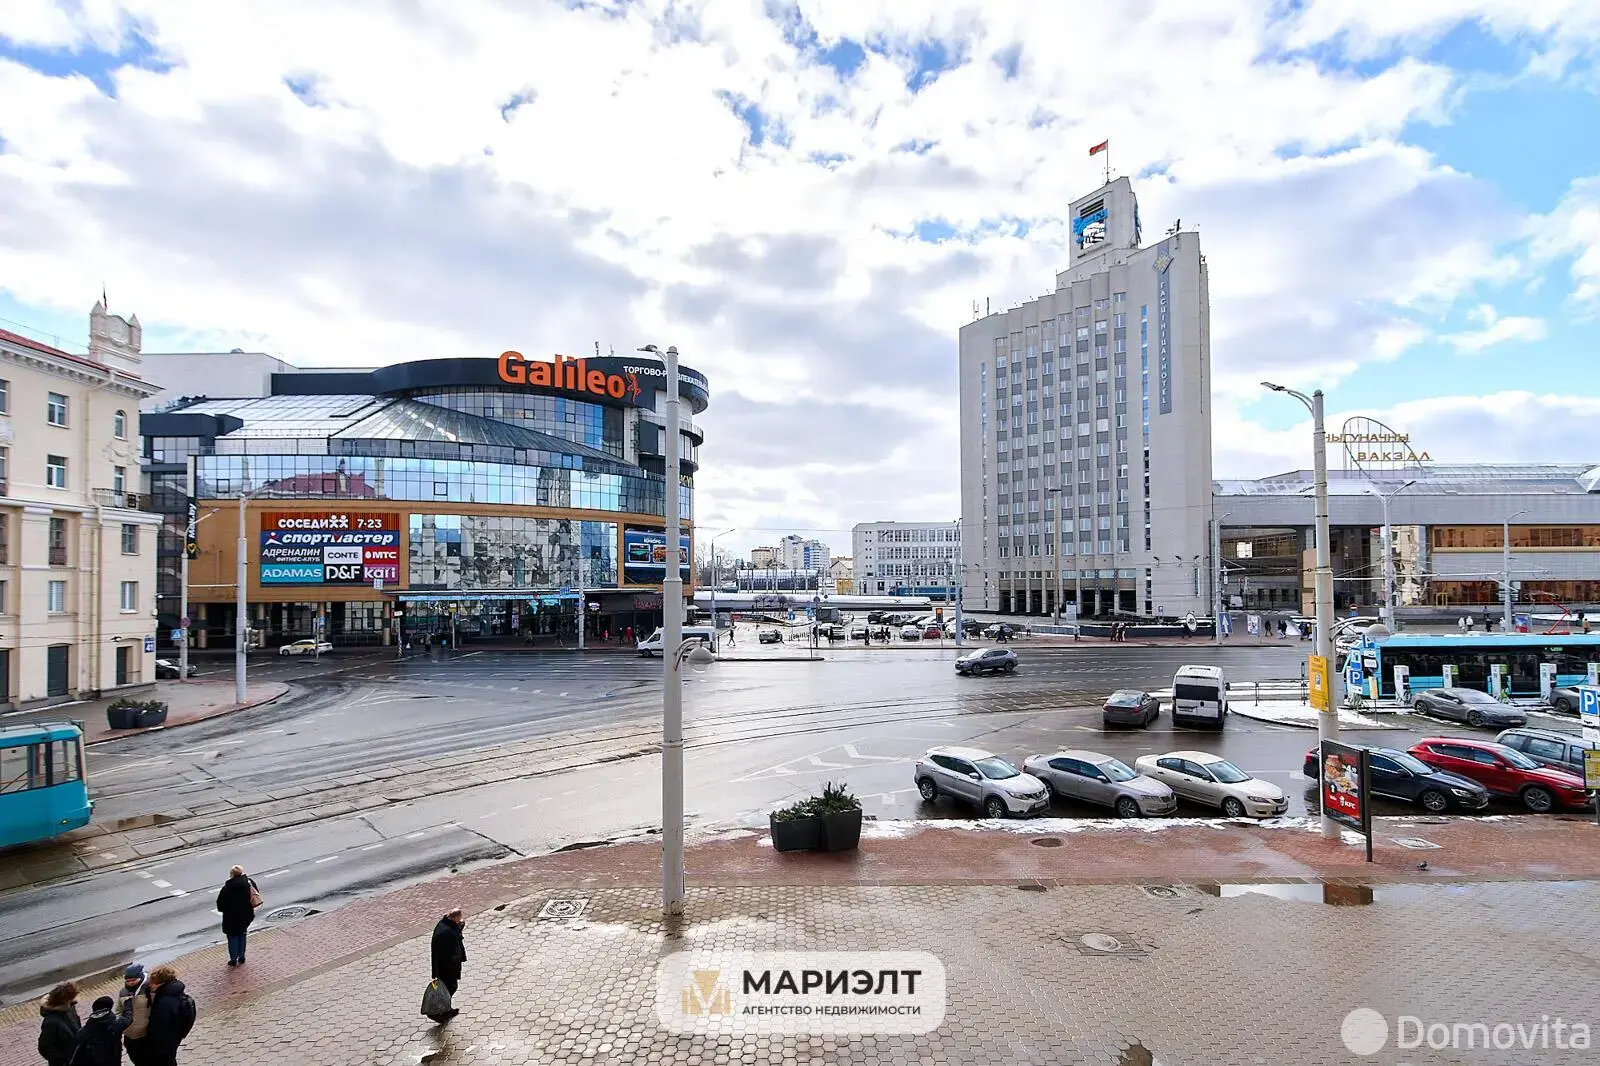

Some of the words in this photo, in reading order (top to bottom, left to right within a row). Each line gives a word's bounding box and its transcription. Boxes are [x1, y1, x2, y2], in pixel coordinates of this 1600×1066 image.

[497, 350, 626, 399] Galileo
[1160, 363, 1168, 404] HOTEL
[1357, 451, 1431, 461] ВАКЗАЛ
[278, 518, 329, 529] СОСЕДИ
[262, 548, 321, 557] АДРЕНАЛИН
[372, 551, 397, 559] МТС
[262, 568, 322, 577] ADAMAS
[325, 565, 361, 580] D&F
[364, 567, 396, 580] kari
[1584, 691, 1595, 712] P
[1345, 799, 1356, 809] KFC
